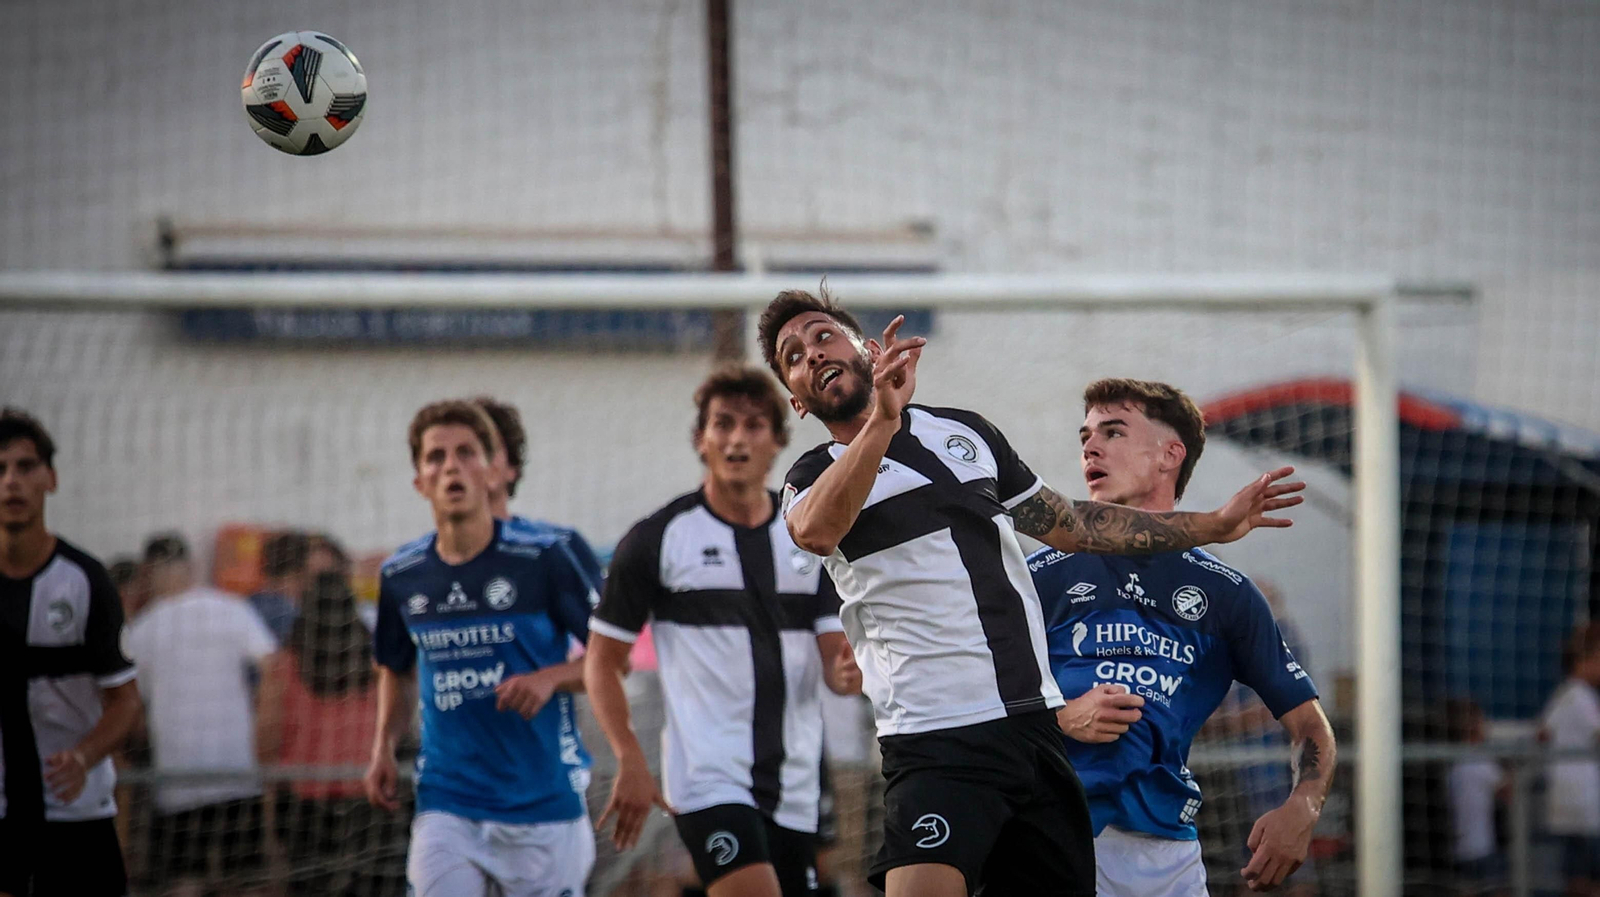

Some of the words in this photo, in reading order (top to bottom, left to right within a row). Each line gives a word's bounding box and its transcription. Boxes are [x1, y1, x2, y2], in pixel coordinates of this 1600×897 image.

[1071, 594, 1096, 604] umbro
[421, 622, 515, 651] HIPOTELS
[1096, 623, 1195, 665] HIPOTELS
[1096, 645, 1132, 657] Hotels
[1133, 645, 1142, 656] &
[433, 661, 505, 692] GROW
[1095, 660, 1183, 696] GROW
[434, 691, 463, 712] UP
[1135, 685, 1172, 709] Capital
